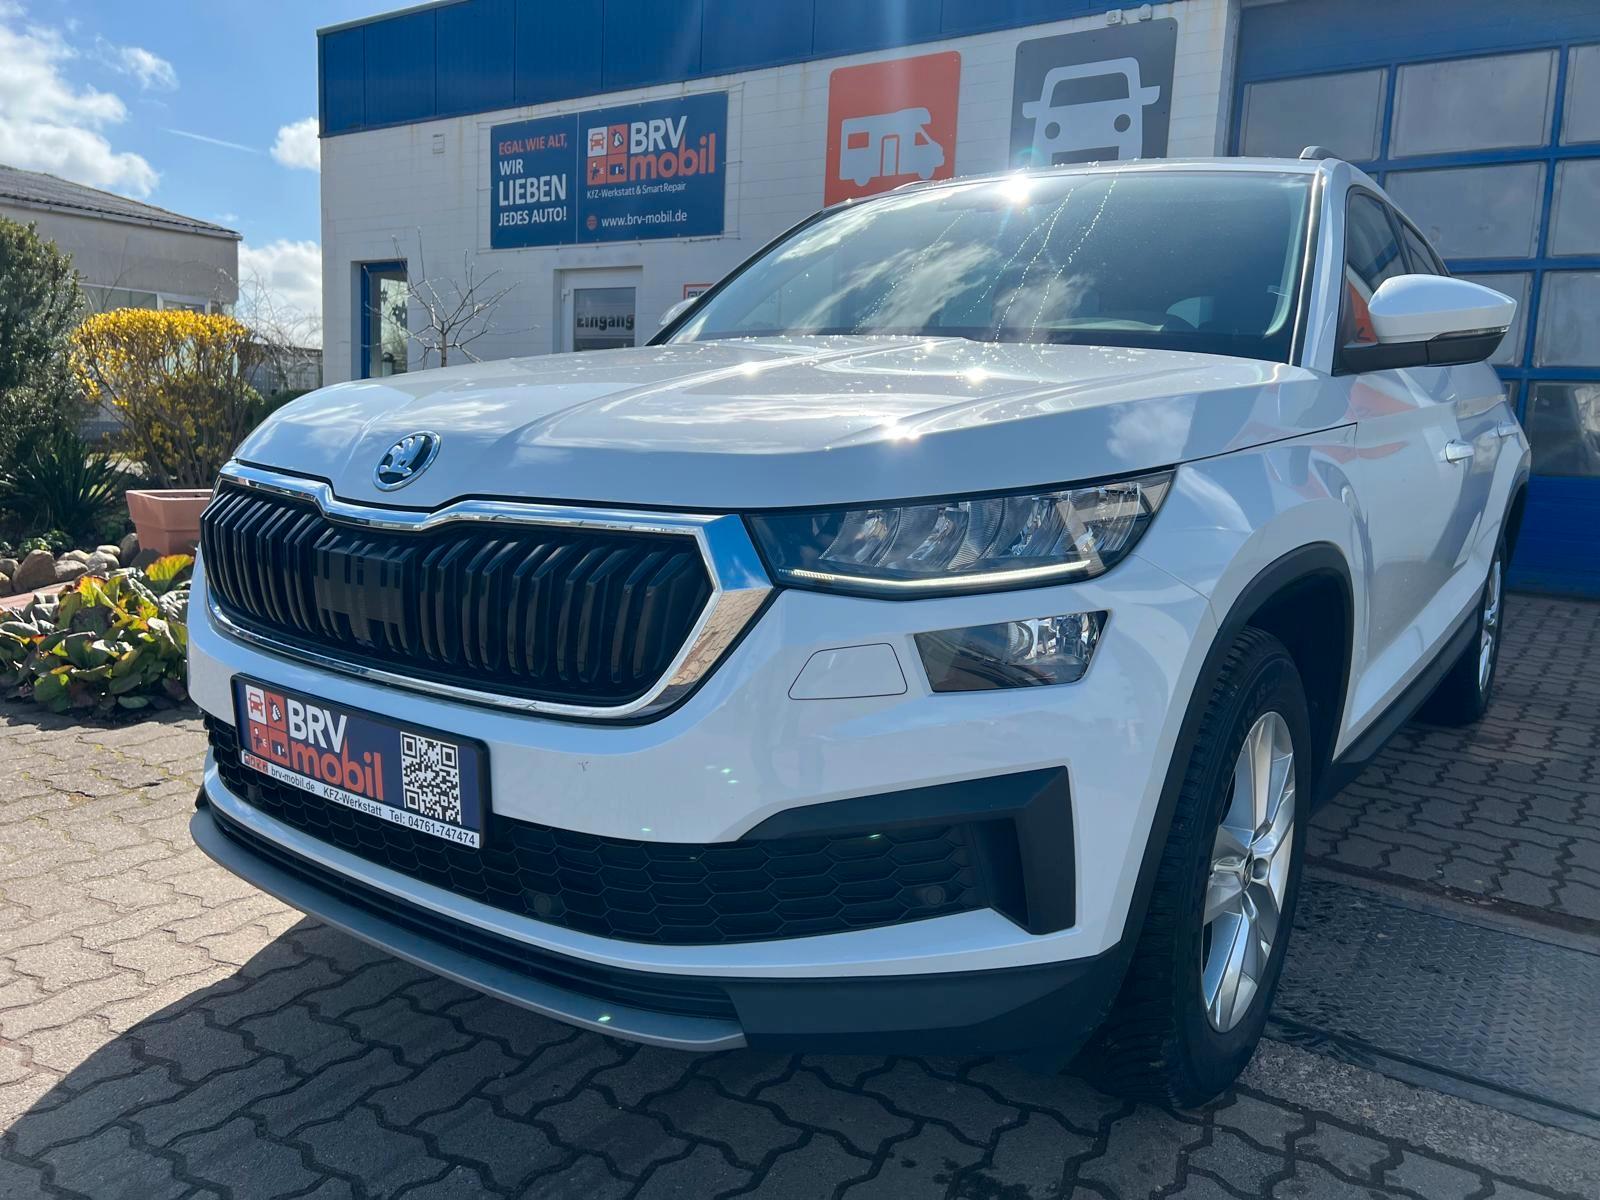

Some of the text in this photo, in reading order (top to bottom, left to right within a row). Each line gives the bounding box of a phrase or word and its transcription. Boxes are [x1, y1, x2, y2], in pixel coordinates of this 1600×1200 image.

[499, 133, 567, 156] EGAL WIE ALT,
[630, 115, 688, 154] BRV
[499, 158, 524, 176] WIR
[629, 132, 716, 181] mobil
[498, 173, 567, 206] LIEBEN
[499, 206, 567, 226] JEDES AUTO!
[601, 209, 688, 227] www.brv-mobil.de
[576, 312, 635, 331] Eingang
[287, 698, 347, 753] BRV
[291, 737, 384, 801] mobil
[271, 766, 475, 846] brv-mobil.de KFZ-Werkstatt Tel: 04761-747474
